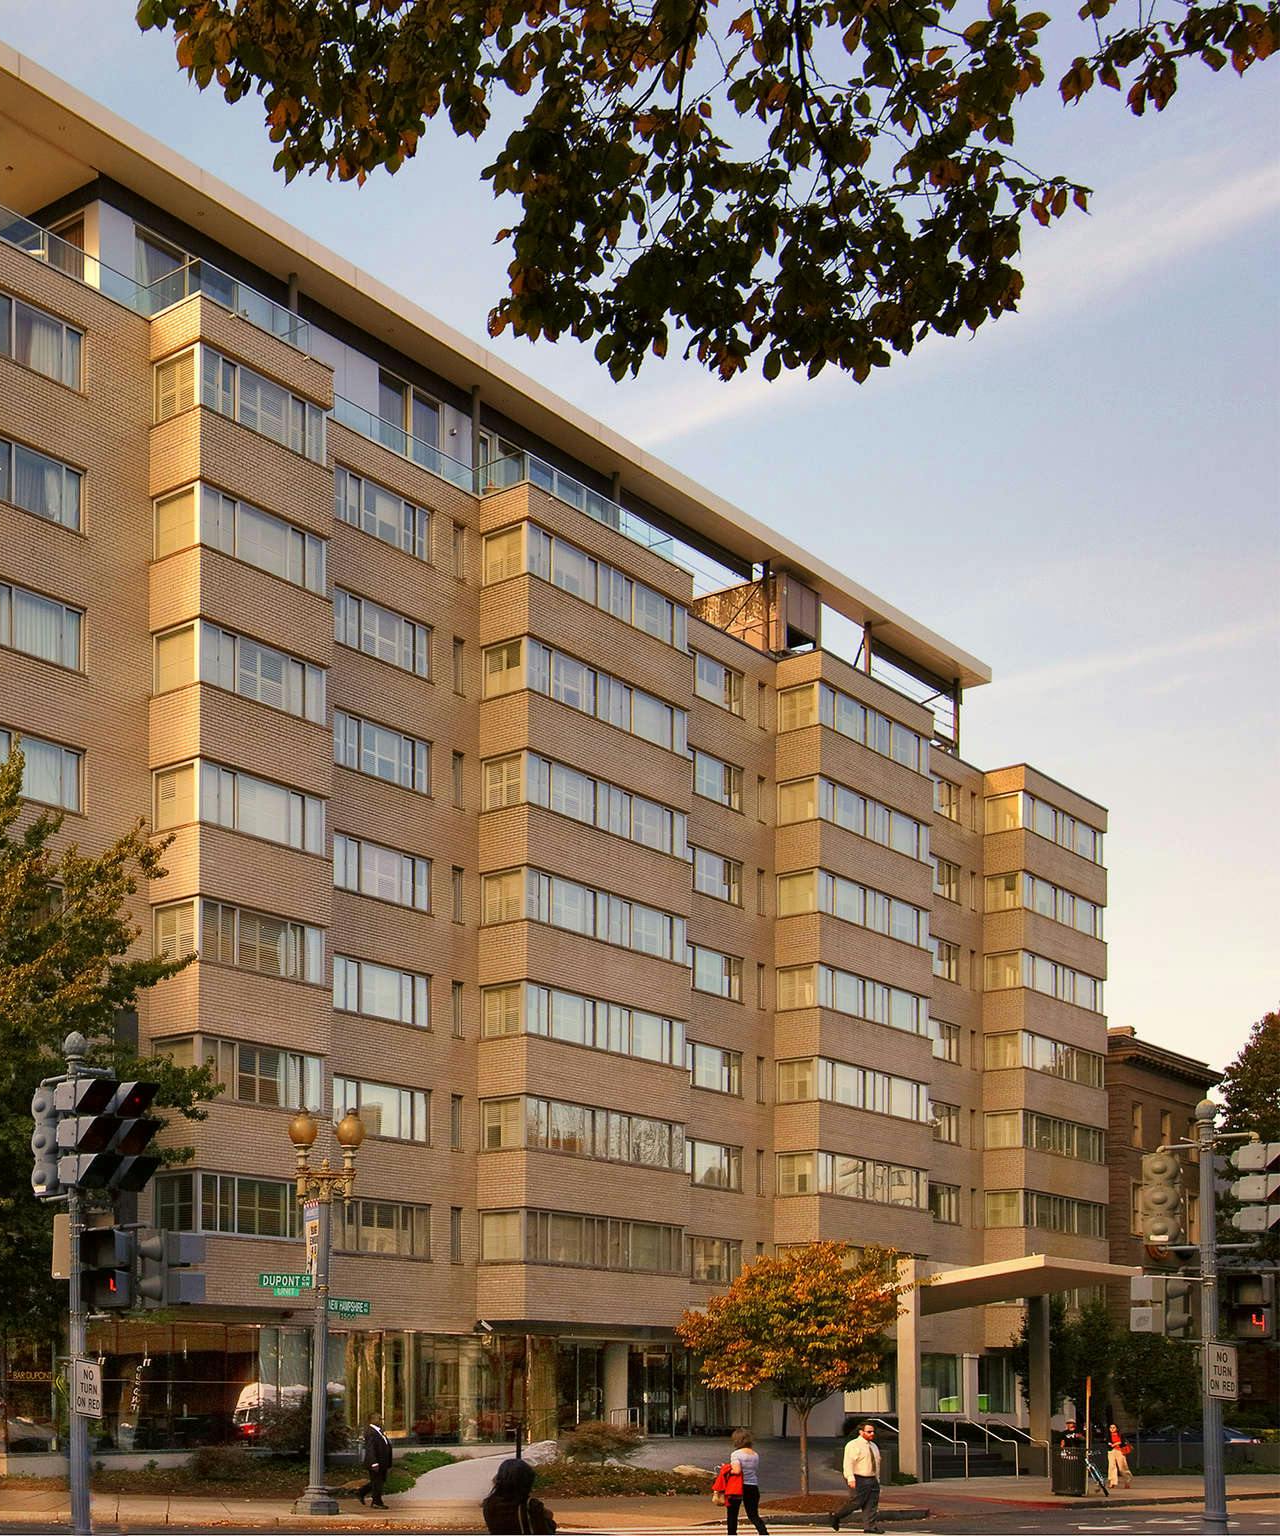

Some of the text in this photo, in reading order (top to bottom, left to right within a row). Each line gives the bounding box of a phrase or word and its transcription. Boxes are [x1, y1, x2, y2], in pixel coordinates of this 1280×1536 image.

[262, 1275, 300, 1286] DUPONT
[339, 1300, 363, 1312] HAMPSHIRE
[1252, 1313, 1265, 1332] 4
[1216, 1351, 1228, 1363] NO
[13, 1371, 52, 1379] BAR DUPONT
[83, 1369, 94, 1380] NO
[1213, 1365, 1232, 1377] TURN
[80, 1382, 98, 1395] TURN
[1210, 1379, 1235, 1392] ON RED
[77, 1396, 100, 1410] ON RED
